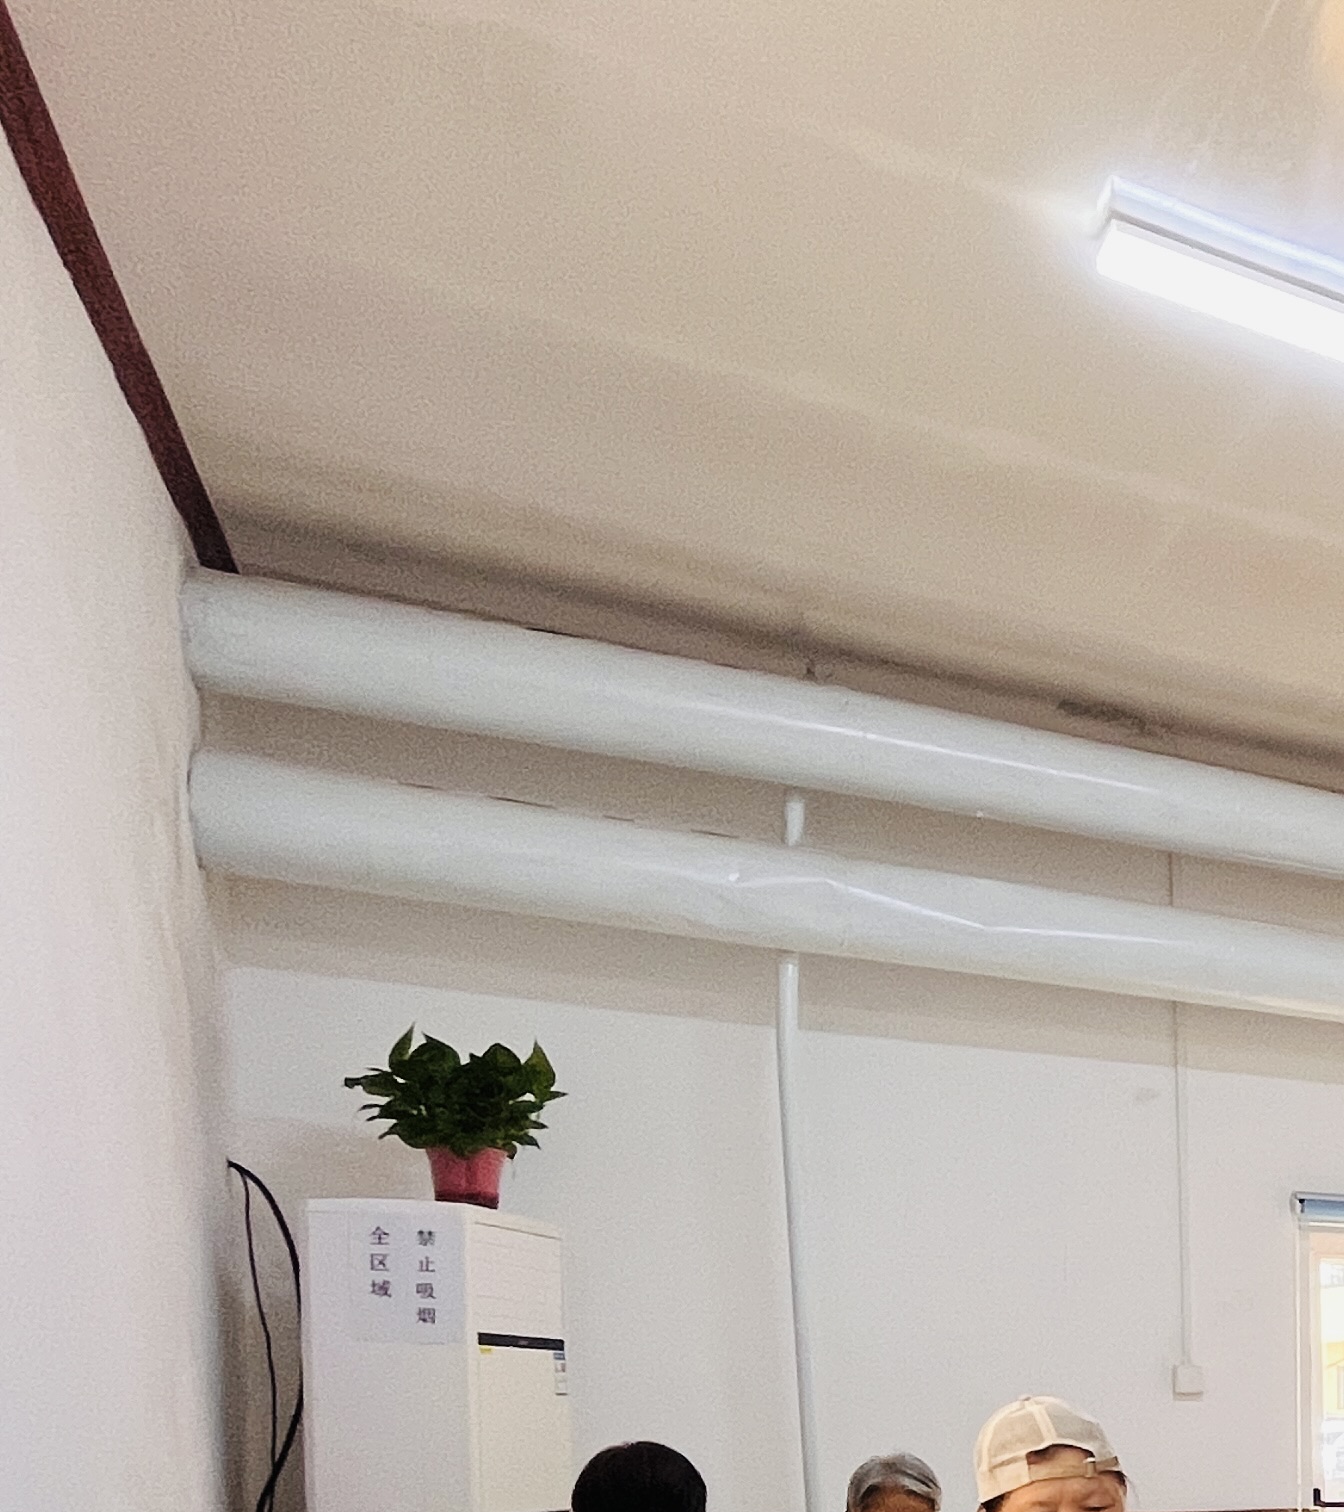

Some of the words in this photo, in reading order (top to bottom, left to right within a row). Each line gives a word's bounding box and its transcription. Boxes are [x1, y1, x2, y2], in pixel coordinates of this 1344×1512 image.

[369, 1226, 392, 1298] 全区域
[416, 1229, 436, 1324] 禁止吸烟
